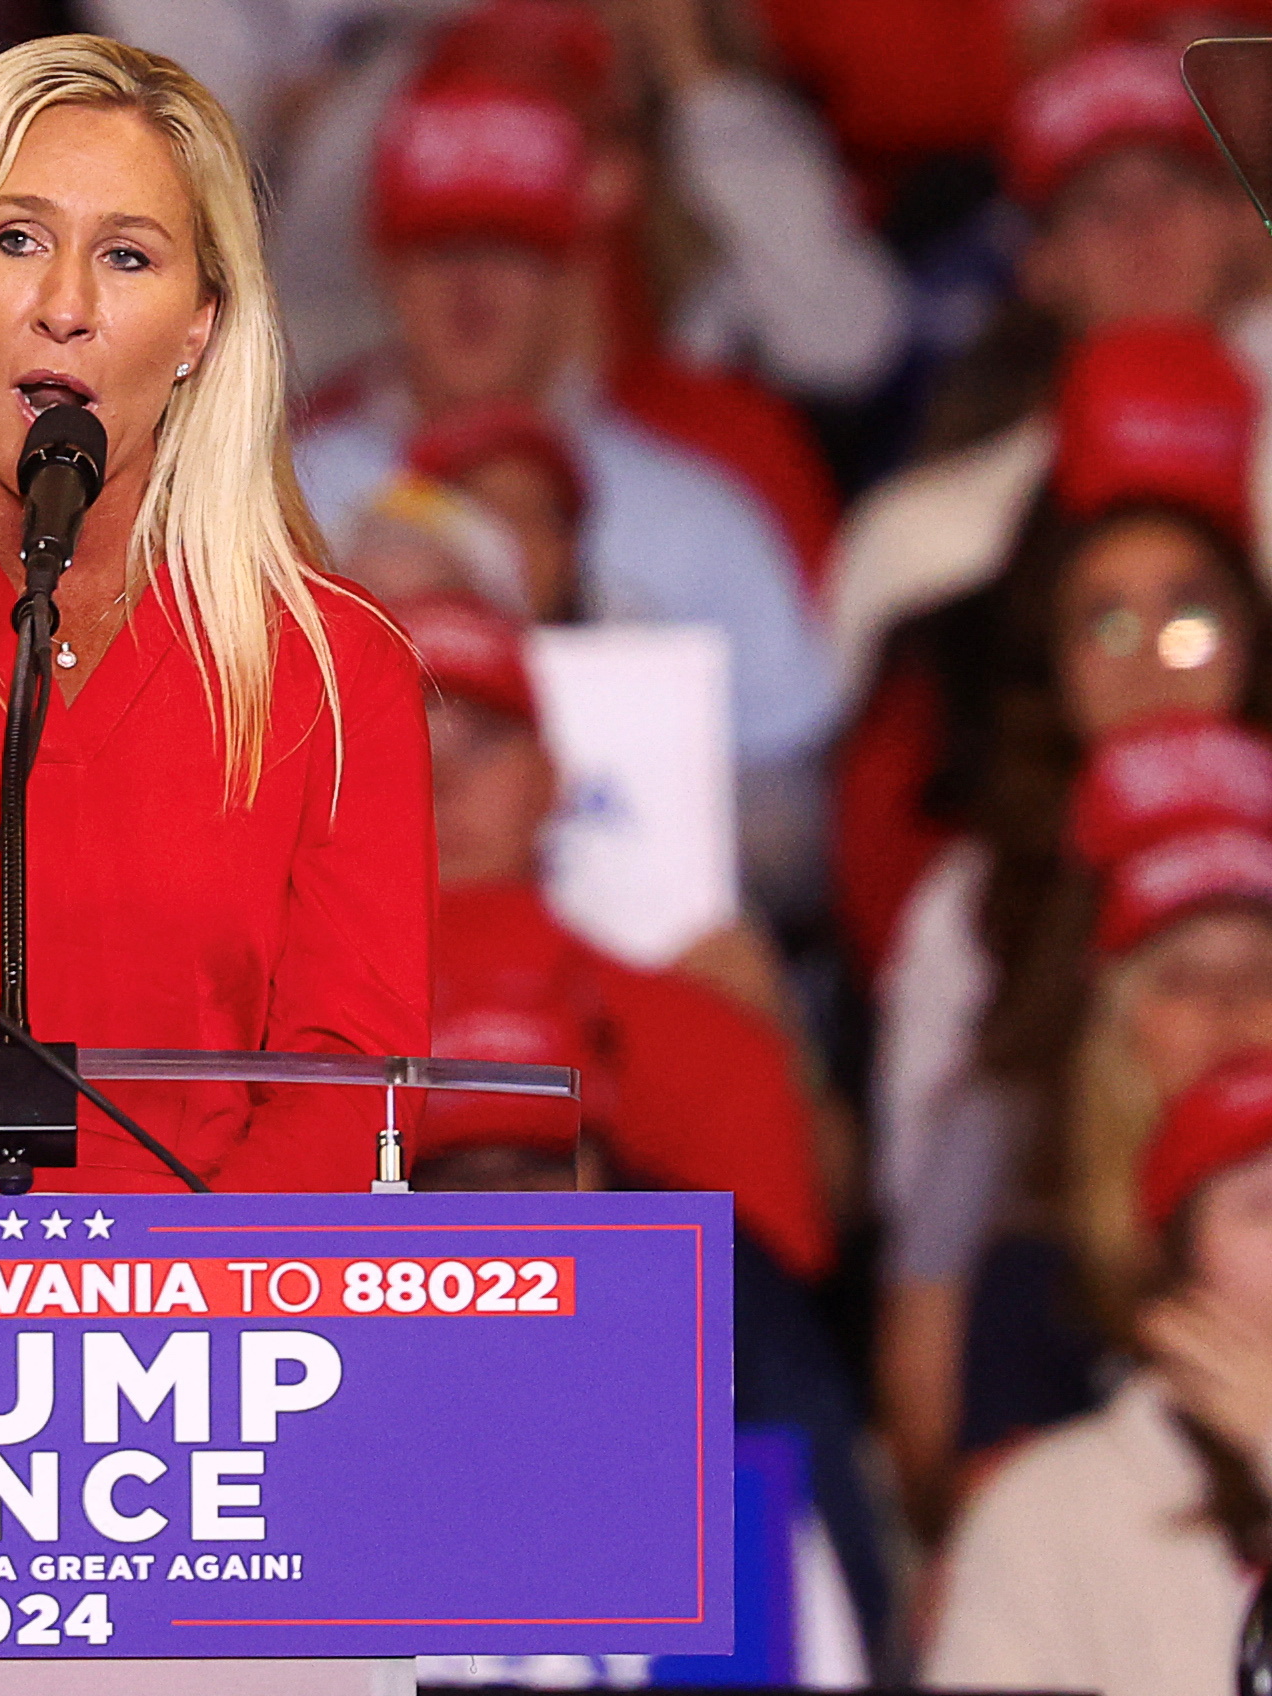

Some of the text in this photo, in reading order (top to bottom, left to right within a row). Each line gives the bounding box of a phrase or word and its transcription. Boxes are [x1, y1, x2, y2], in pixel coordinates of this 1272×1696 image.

[227, 1261, 320, 1313] TO
[342, 1260, 559, 1313] 88022
[31, 1554, 155, 1581] GREAT
[166, 1554, 303, 1581] AGAIN!
